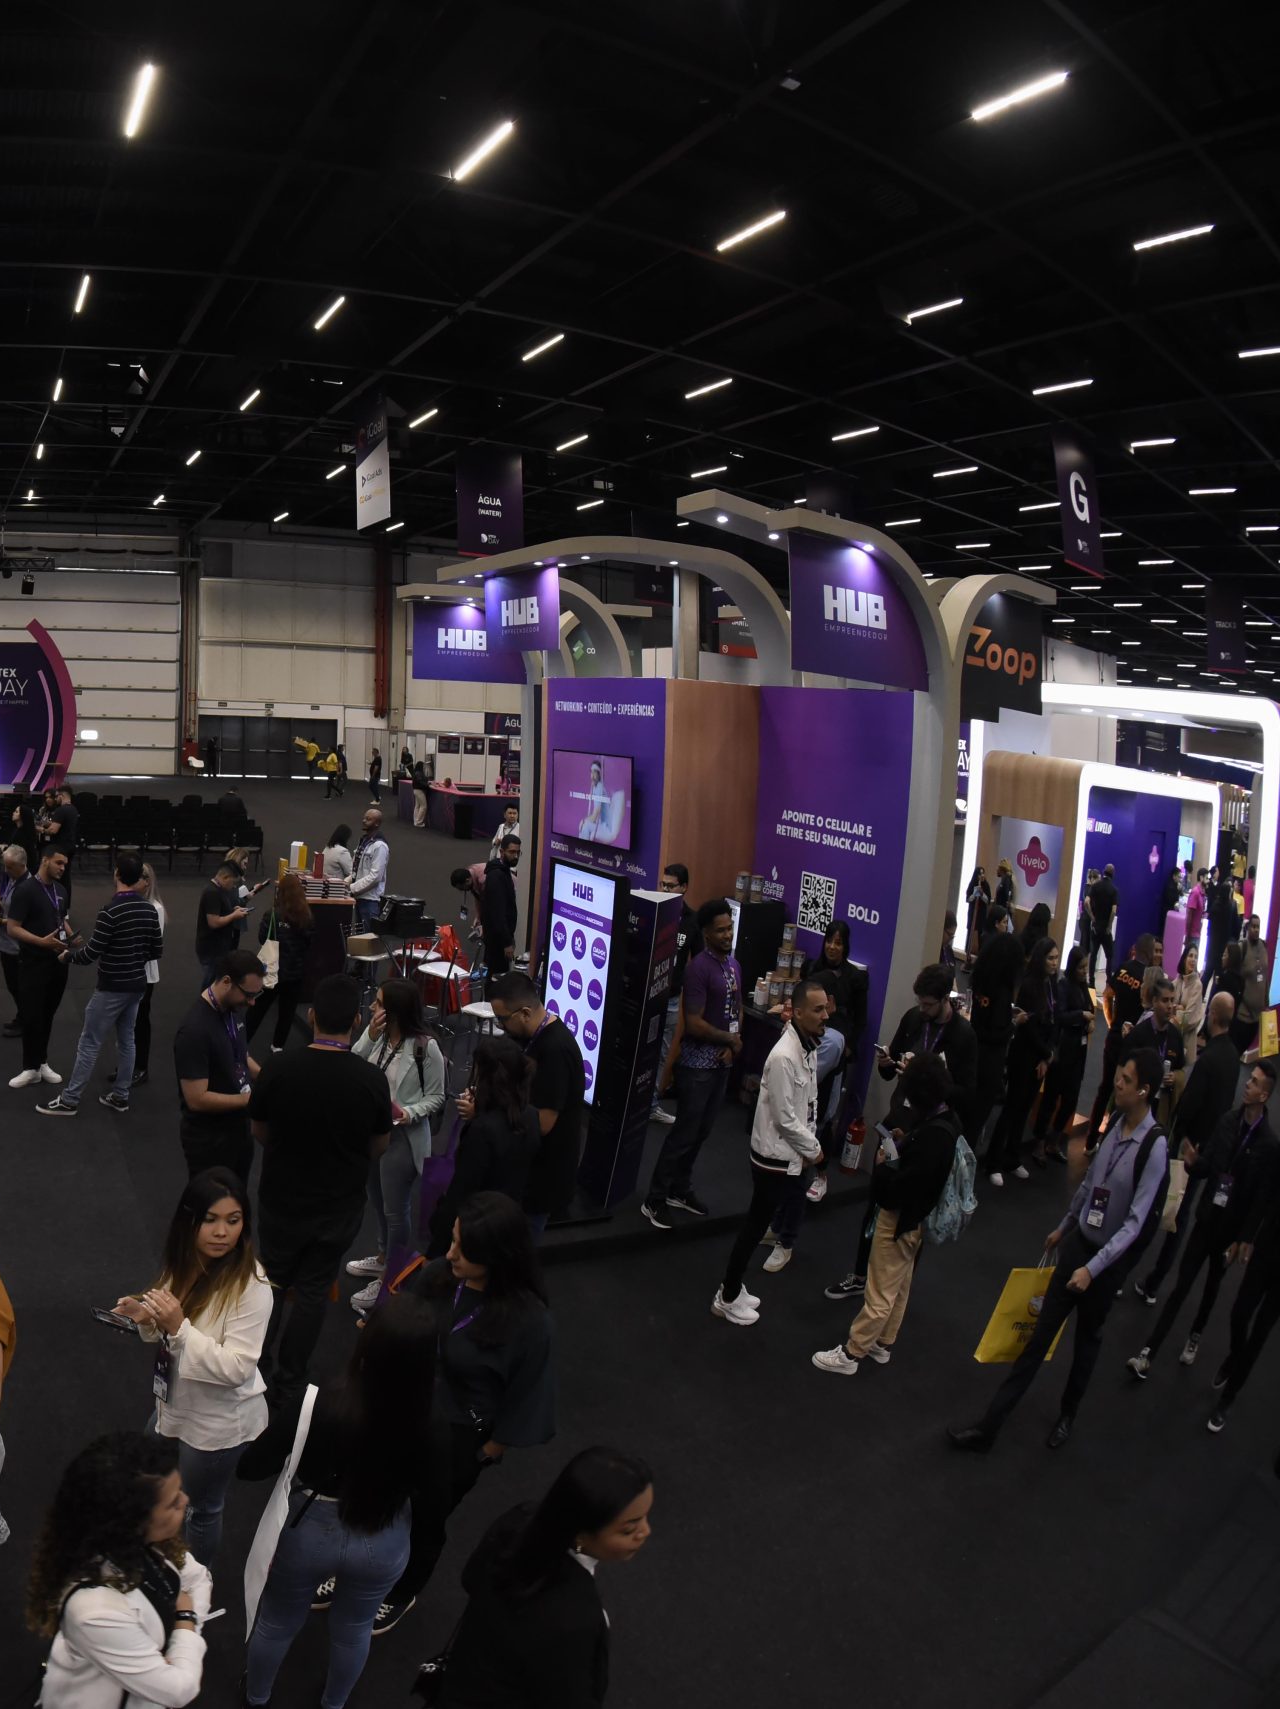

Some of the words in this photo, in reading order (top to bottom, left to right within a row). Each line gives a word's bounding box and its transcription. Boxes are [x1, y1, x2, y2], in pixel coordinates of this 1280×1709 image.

[477, 493, 502, 507] ÁGUA
[1069, 471, 1091, 524] G
[478, 508, 502, 518] (WATER)
[501, 596, 539, 627] HUB
[823, 584, 887, 630] HUB
[437, 627, 487, 651] HUB
[824, 623, 888, 641] EMPREENDEDOR
[966, 625, 1037, 686] Zoop
[555, 700, 584, 713] NETWORKING
[587, 700, 613, 715] CONTEÚDO
[617, 702, 655, 717] EXPERIÊNCIAS
[781, 809, 815, 826] APONTE
[816, 815, 823, 827] O
[825, 817, 865, 836] CELULAR
[866, 825, 872, 838] E
[1094, 821, 1113, 835] LIVELO
[776, 824, 804, 841] RETIRE
[805, 830, 820, 843] SEU
[822, 833, 851, 851] SNACK
[853, 840, 876, 856] AQUI
[1020, 854, 1047, 870] livelo
[572, 881, 593, 903] HUB
[762, 887, 784, 899] COFFEE
[764, 880, 785, 892] SUPER
[848, 903, 880, 925] BOLD
[1117, 969, 1140, 989] Zoop
[584, 1029, 597, 1042] BOLD
